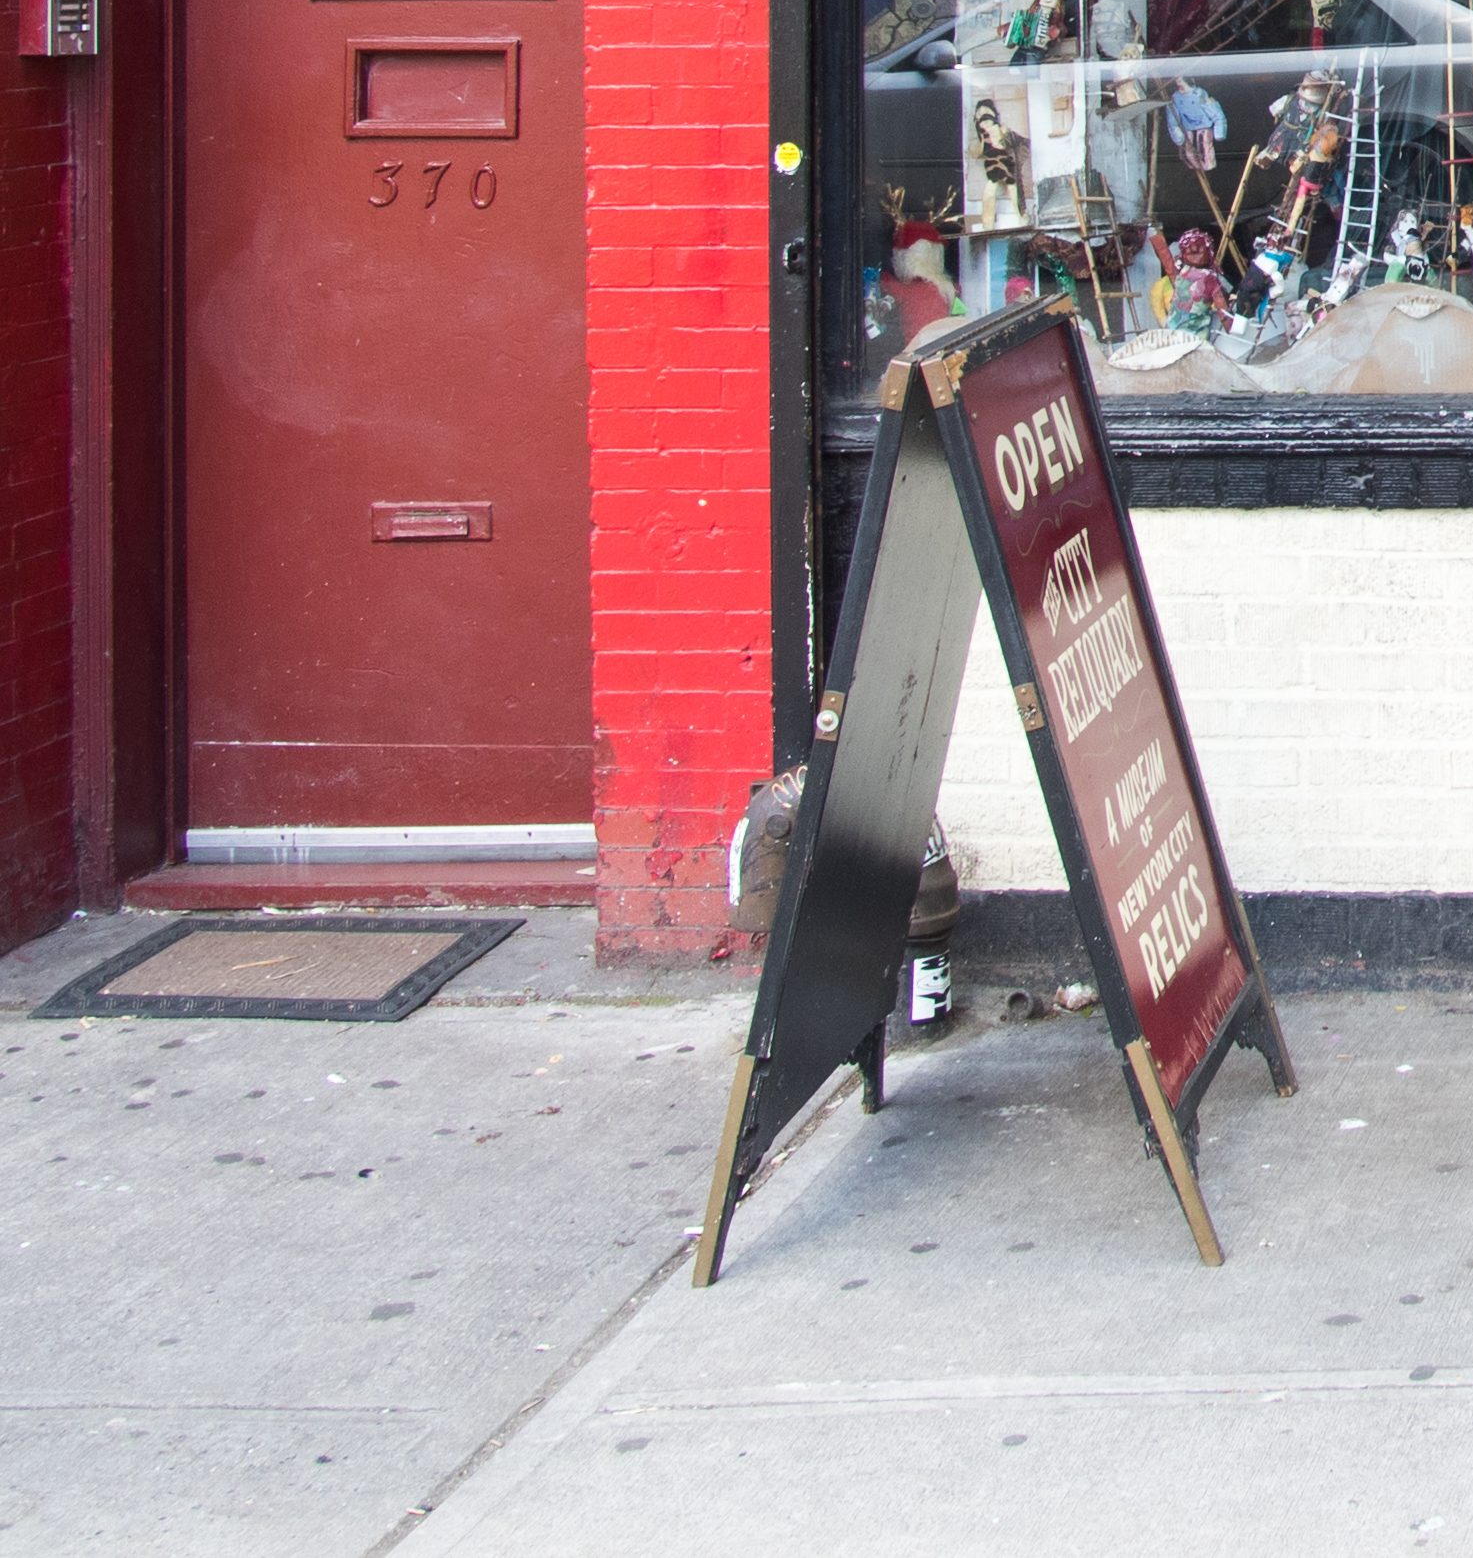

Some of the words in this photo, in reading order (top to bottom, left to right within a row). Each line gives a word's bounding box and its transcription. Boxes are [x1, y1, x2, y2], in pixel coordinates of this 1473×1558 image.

[368, 160, 498, 209] 370
[995, 395, 1084, 511] OPEN
[1054, 527, 1103, 625] CITY
[1047, 594, 1144, 744] RELIQUARY
[1105, 796, 1120, 847] A
[1116, 738, 1167, 831] MUSEUM
[1139, 815, 1154, 848] OF
[1117, 875, 1148, 933] NEW
[1144, 849, 1174, 898] YORK
[1169, 810, 1195, 863] CITY
[1138, 863, 1208, 1002] RELICS
